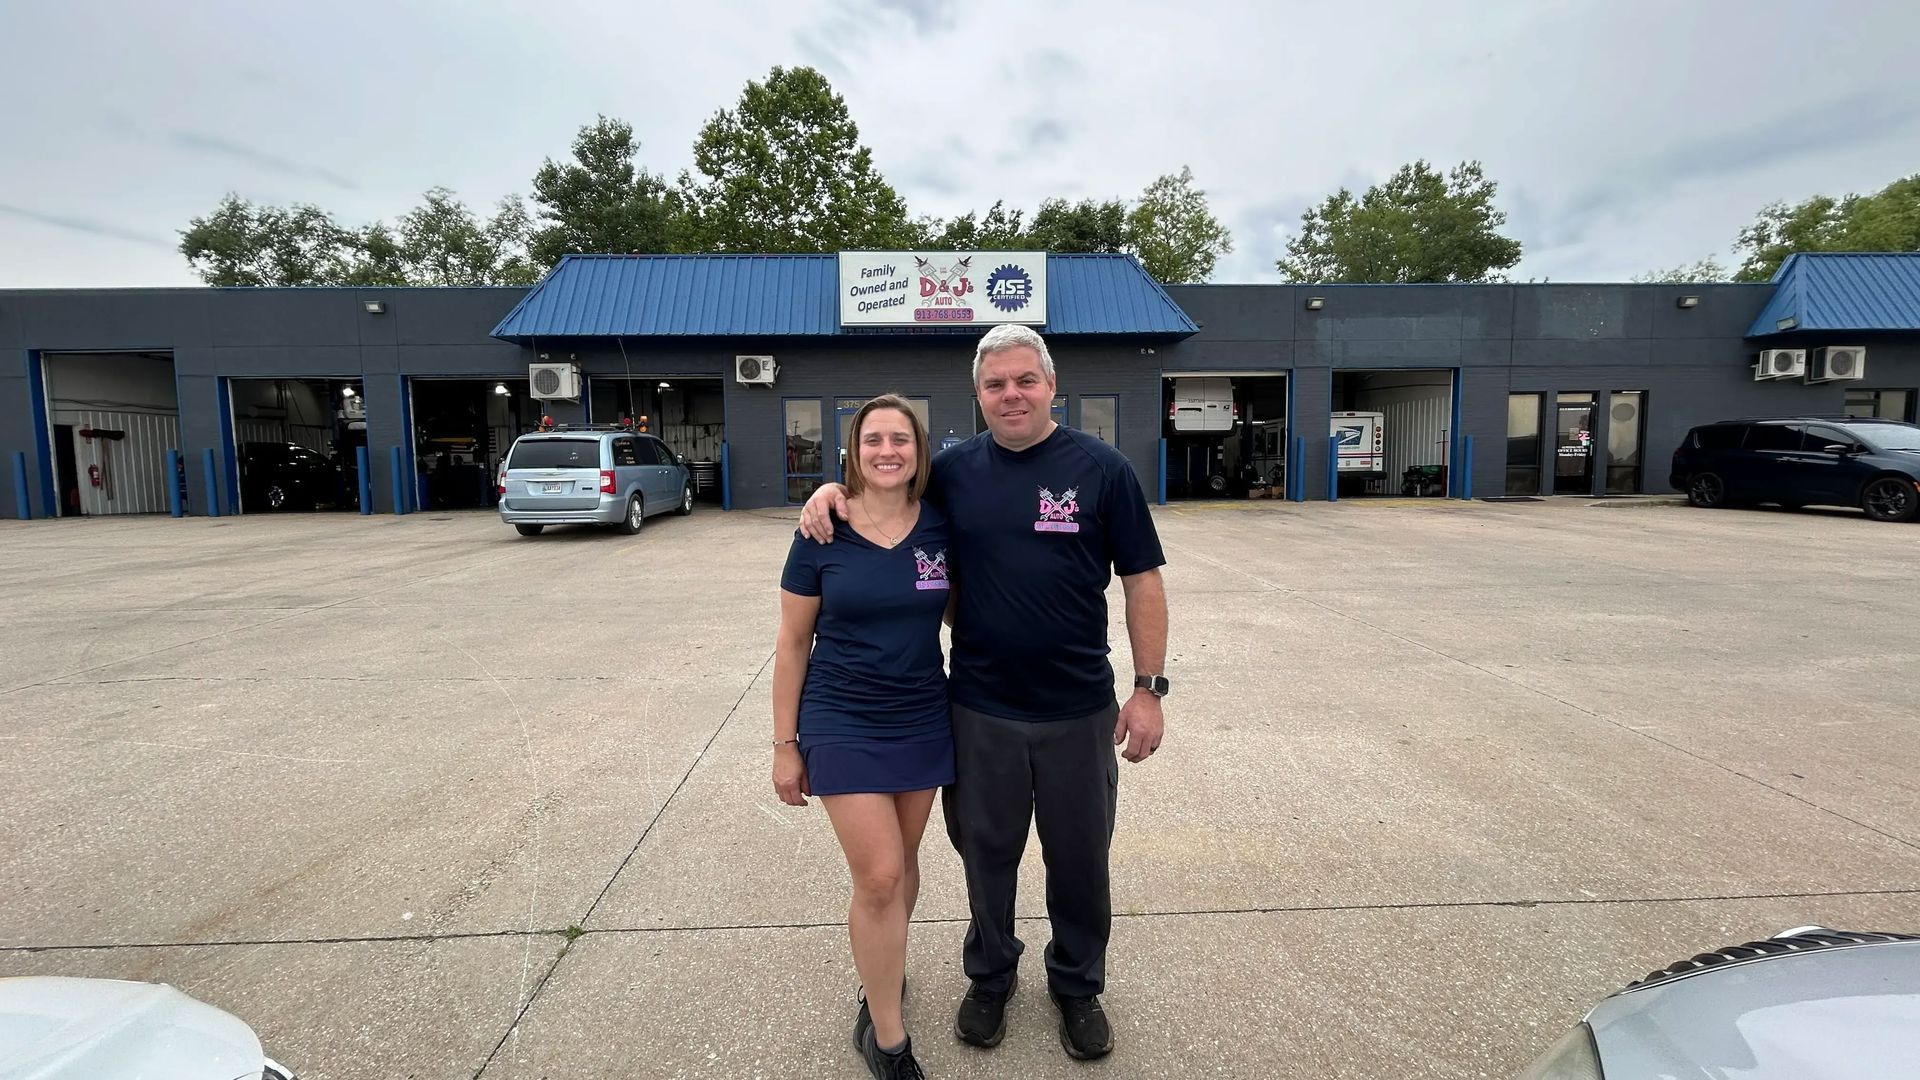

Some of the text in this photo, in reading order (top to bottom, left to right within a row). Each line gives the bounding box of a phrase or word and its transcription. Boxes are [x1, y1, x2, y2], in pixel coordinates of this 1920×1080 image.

[861, 264, 896, 279] Family
[850, 276, 909, 297] Owned and
[919, 276, 974, 298] D & J's
[992, 279, 1025, 295] ASE
[857, 293, 906, 313] Operated
[935, 297, 953, 306] AUTO
[843, 400, 860, 409] 375
